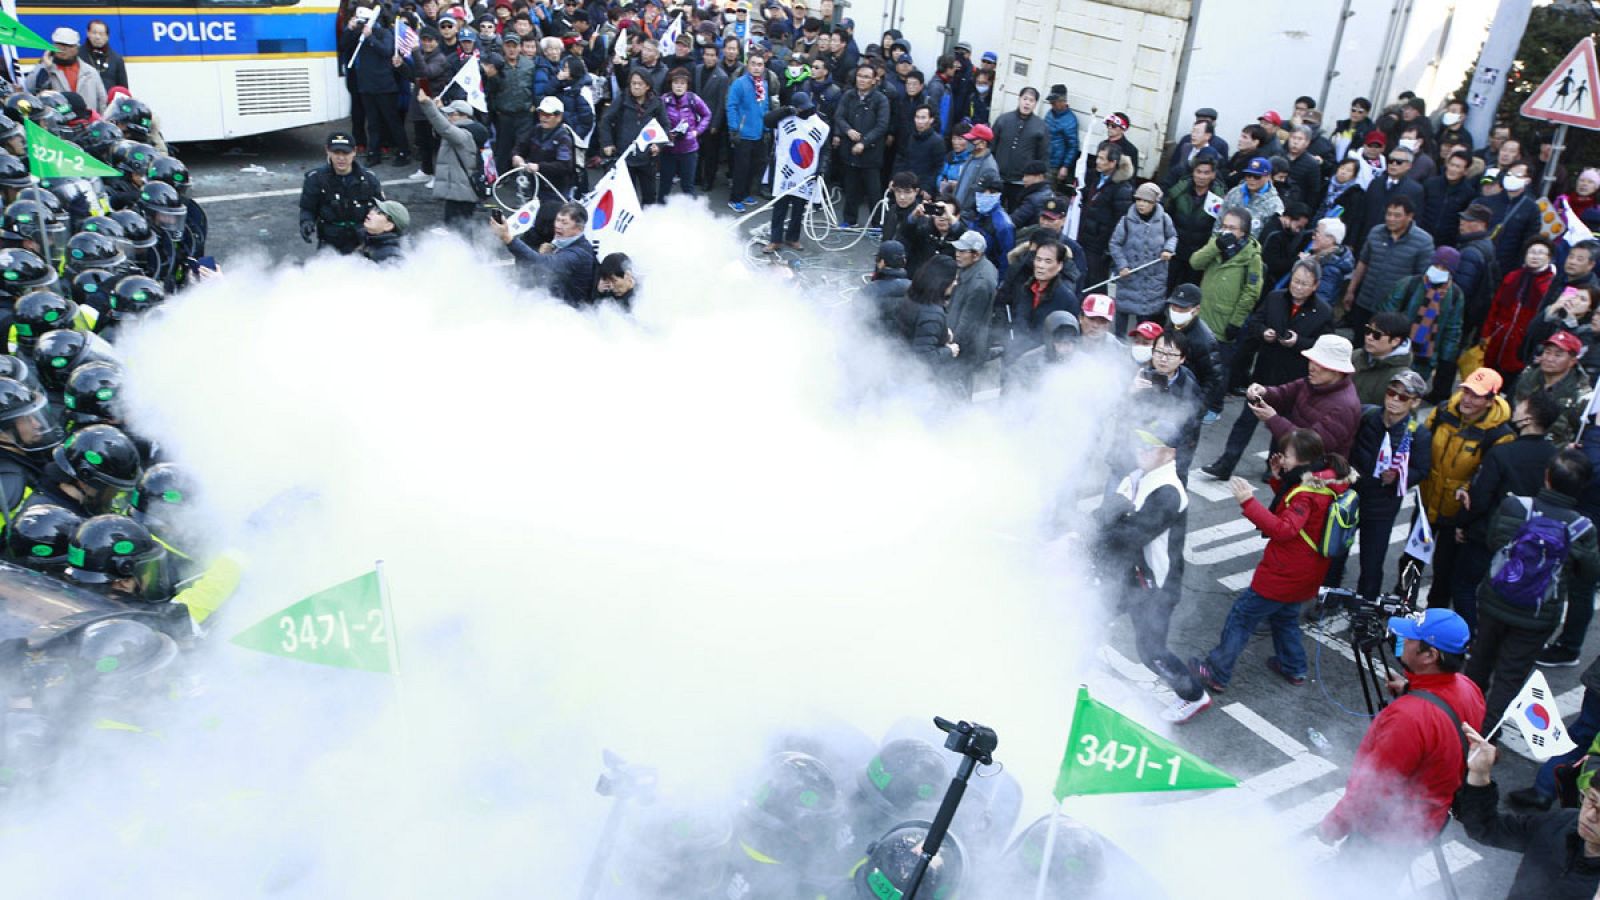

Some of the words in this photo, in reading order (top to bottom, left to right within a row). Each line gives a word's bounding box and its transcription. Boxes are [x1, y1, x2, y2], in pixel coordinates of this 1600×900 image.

[153, 21, 236, 41] POLICE
[32, 144, 84, 171] 32기-2
[280, 610, 386, 652] 34기-2
[1077, 734, 1181, 785] 34기-1
